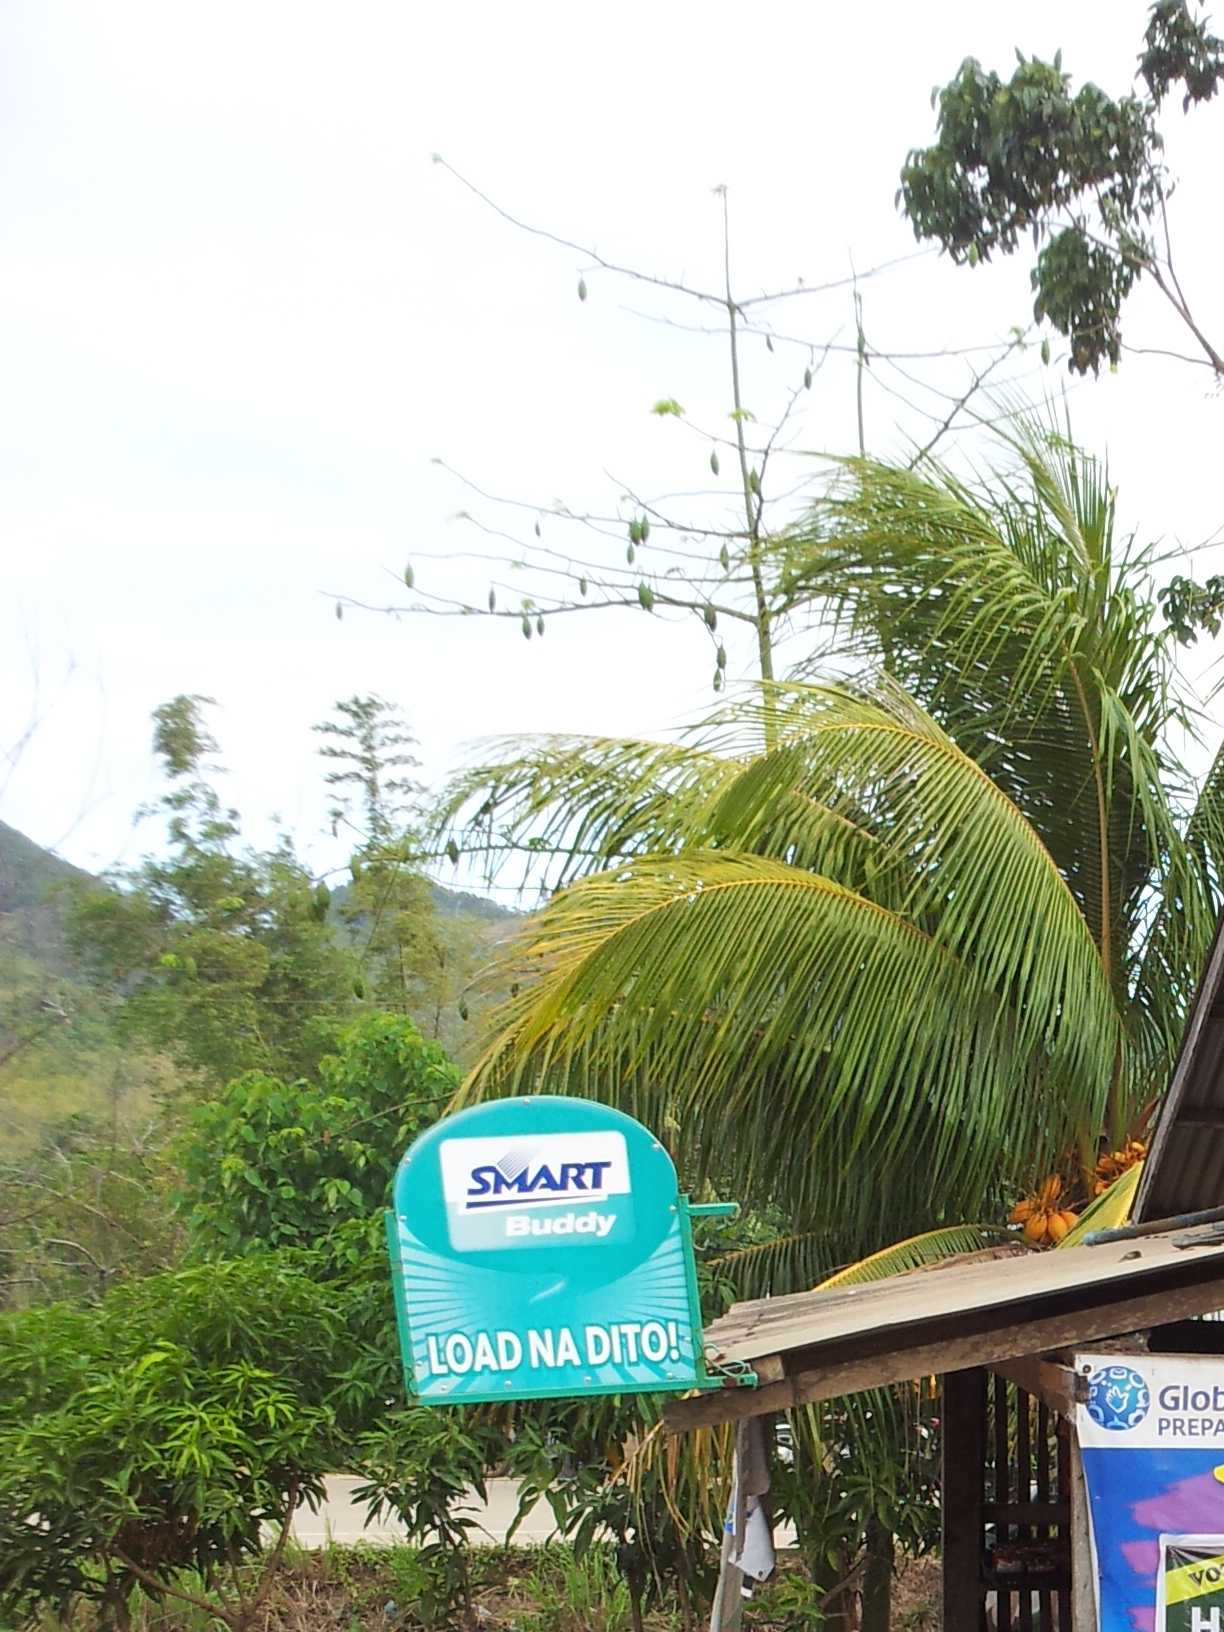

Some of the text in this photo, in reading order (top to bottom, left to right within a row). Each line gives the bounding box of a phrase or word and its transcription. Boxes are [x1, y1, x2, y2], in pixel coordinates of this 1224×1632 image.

[467, 1161, 612, 1196] SMART
[505, 1212, 617, 1238] Buddy
[427, 1321, 681, 1375] LOAD NA DITO!
